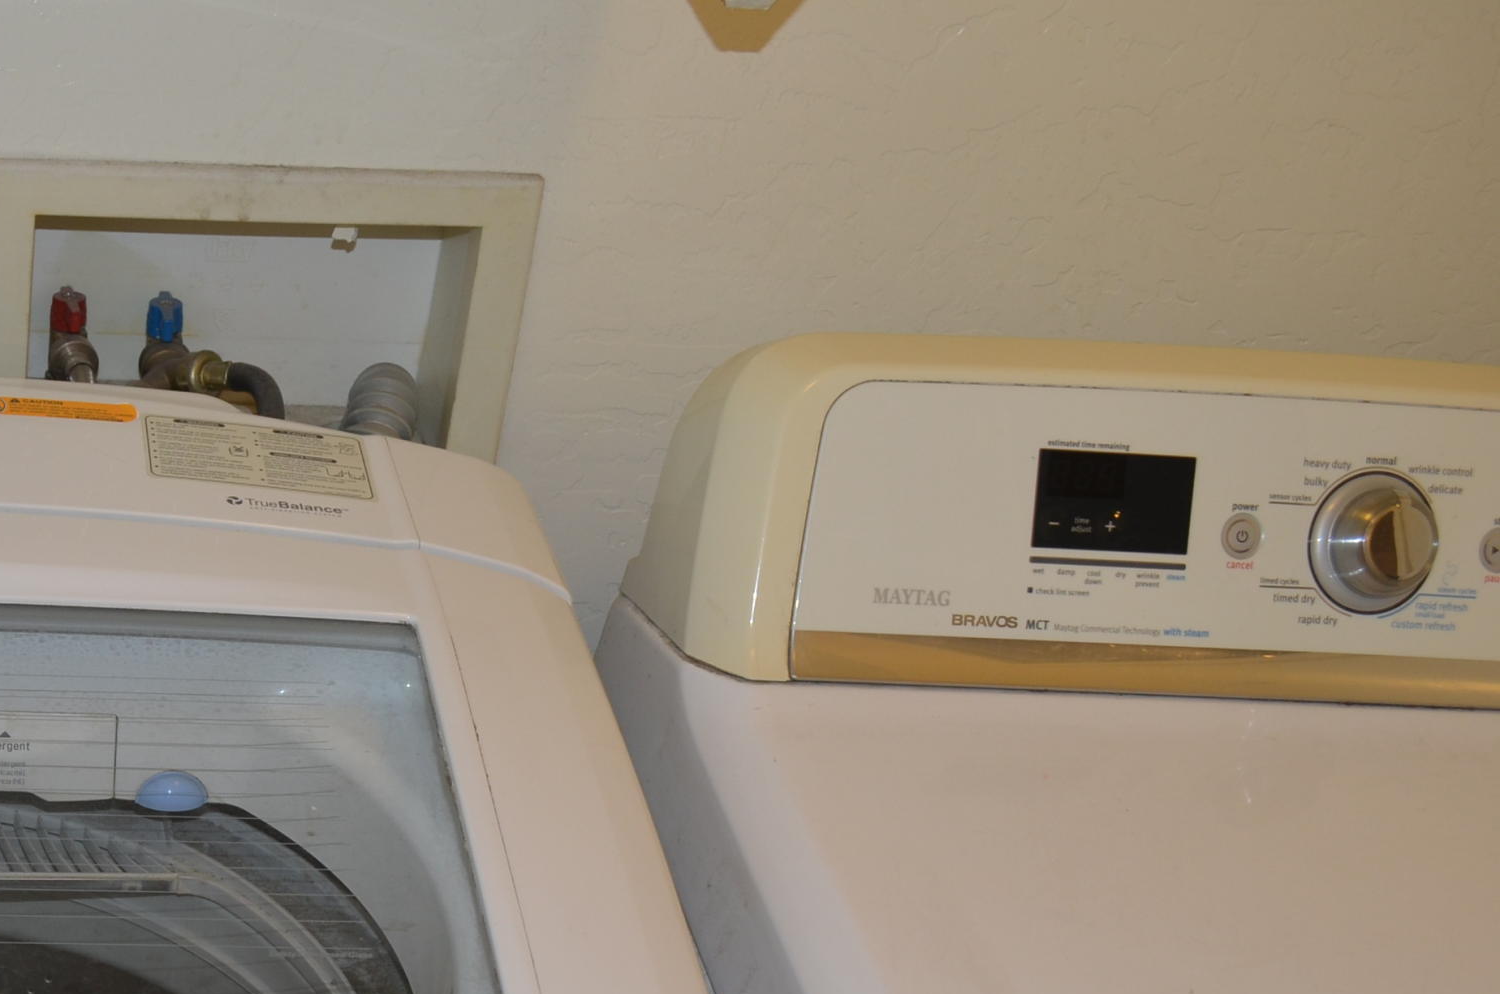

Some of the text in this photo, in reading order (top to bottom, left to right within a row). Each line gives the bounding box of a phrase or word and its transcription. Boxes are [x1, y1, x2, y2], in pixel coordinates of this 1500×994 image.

[1048, 440, 1130, 451] estimated time remaining
[1303, 458, 1352, 470] heavy duty
[1366, 456, 1397, 465] normal
[1303, 476, 1329, 487] bulky
[1291, 494, 1312, 502] cycles
[1232, 503, 1259, 512] power
[1226, 561, 1254, 570] cancel
[1057, 568, 1075, 576] damp
[872, 587, 950, 607] MAYTAG
[1273, 593, 1316, 605] timed dry
[951, 614, 1018, 628] BRAVOS
[1026, 619, 1050, 630] MCT
[1163, 628, 1181, 637] with
[1298, 616, 1338, 627] rapid dry
